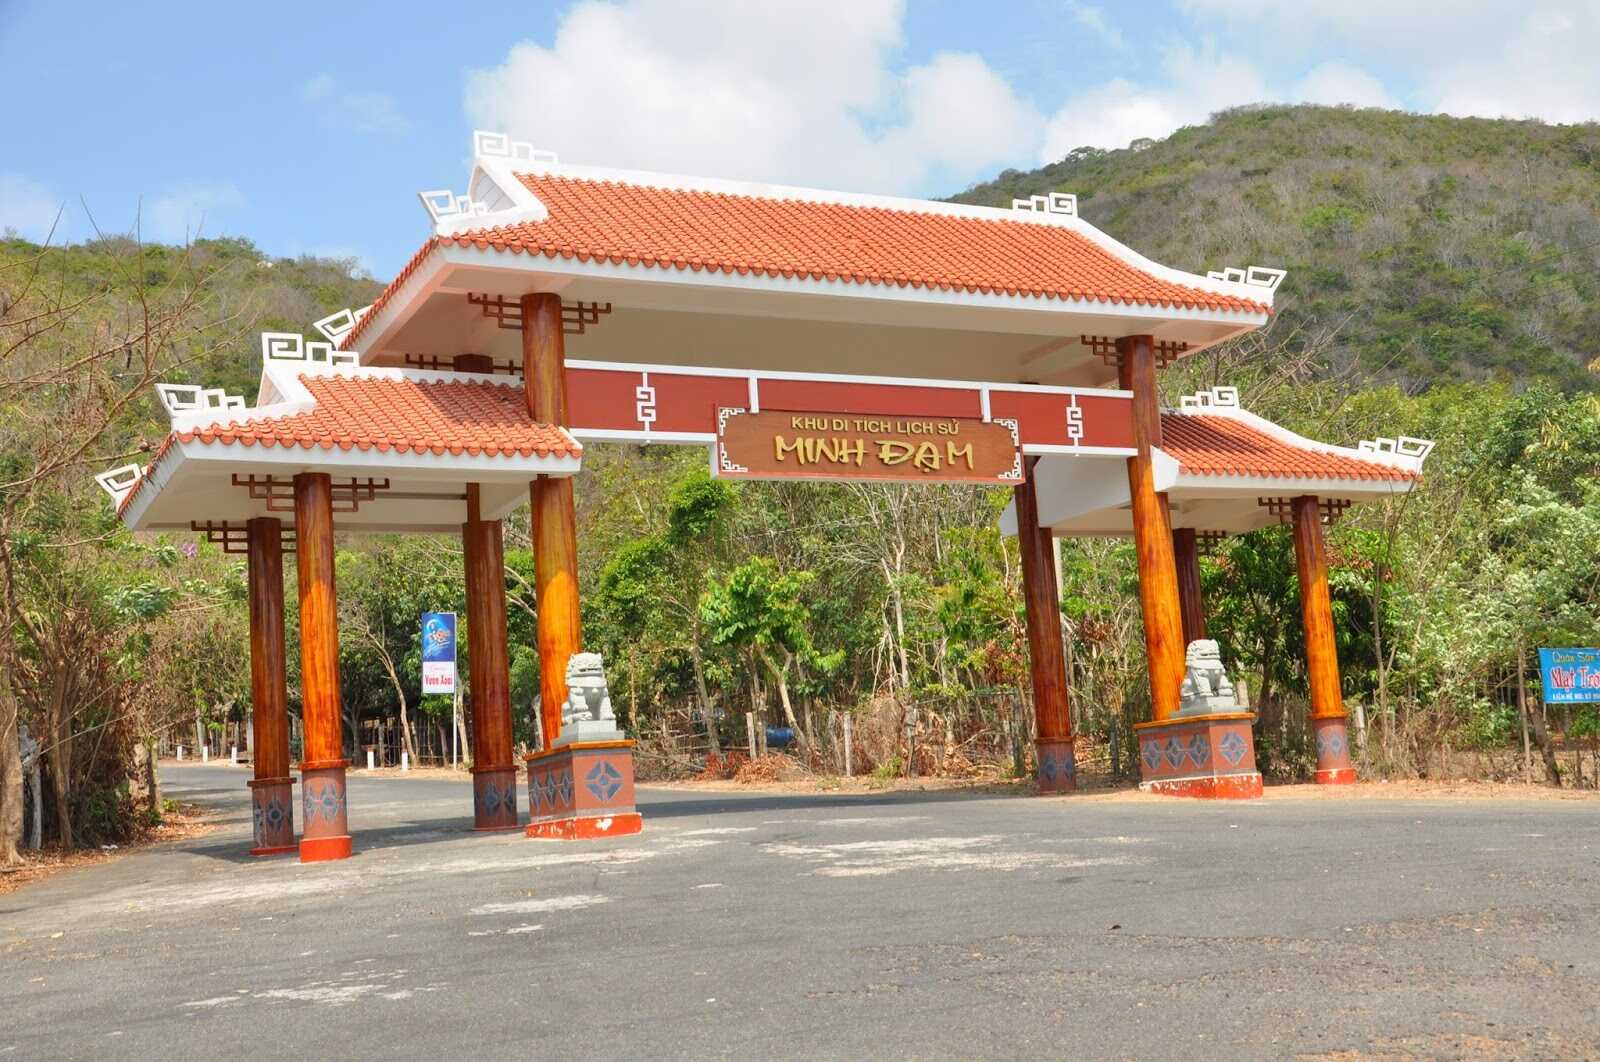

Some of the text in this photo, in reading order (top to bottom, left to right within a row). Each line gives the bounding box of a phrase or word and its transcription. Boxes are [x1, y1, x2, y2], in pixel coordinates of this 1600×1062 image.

[791, 416, 960, 437] KHU DI TÍCH LỊCH SỬ
[774, 434, 975, 474] MINH ĐẠM
